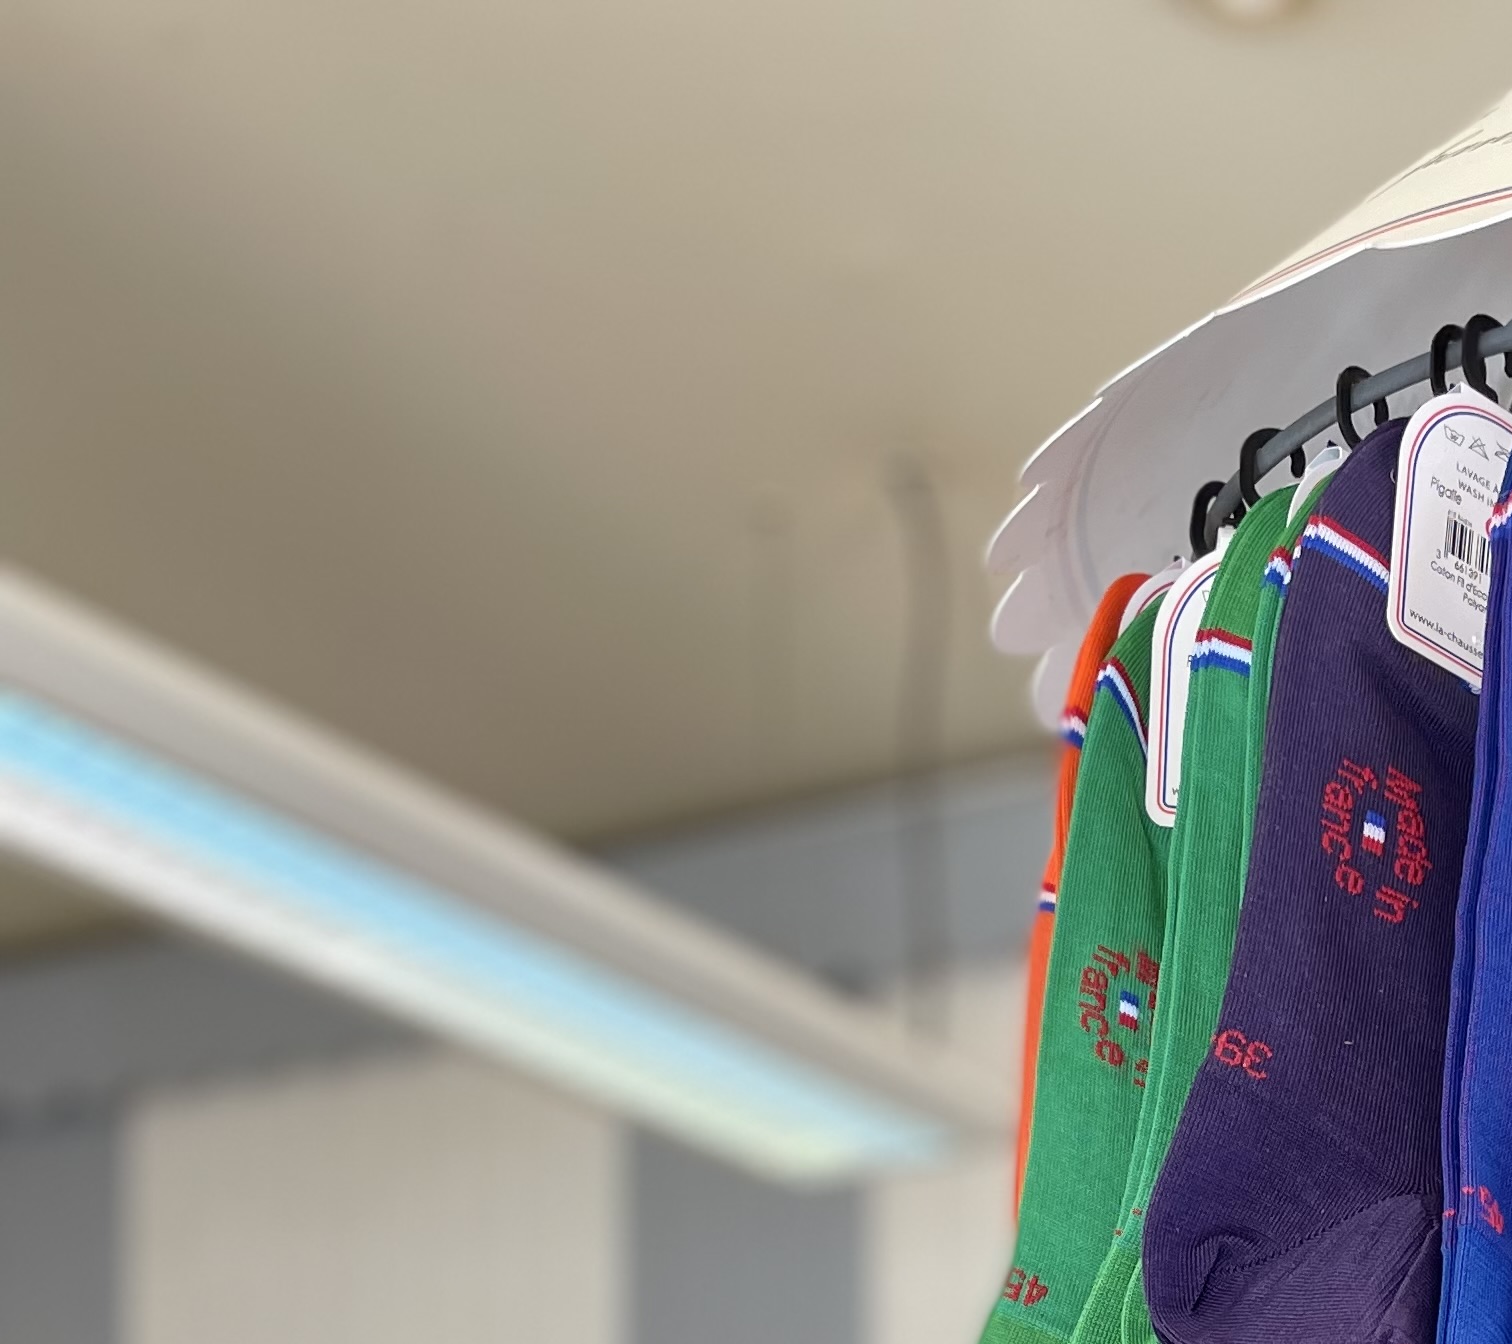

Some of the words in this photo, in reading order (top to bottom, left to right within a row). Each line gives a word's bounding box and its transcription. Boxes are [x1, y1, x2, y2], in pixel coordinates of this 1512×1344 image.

[1457, 479, 1486, 504] WASH
[1408, 609, 1484, 660] www.la-chausse
[1211, 1028, 1274, 1080] 39
